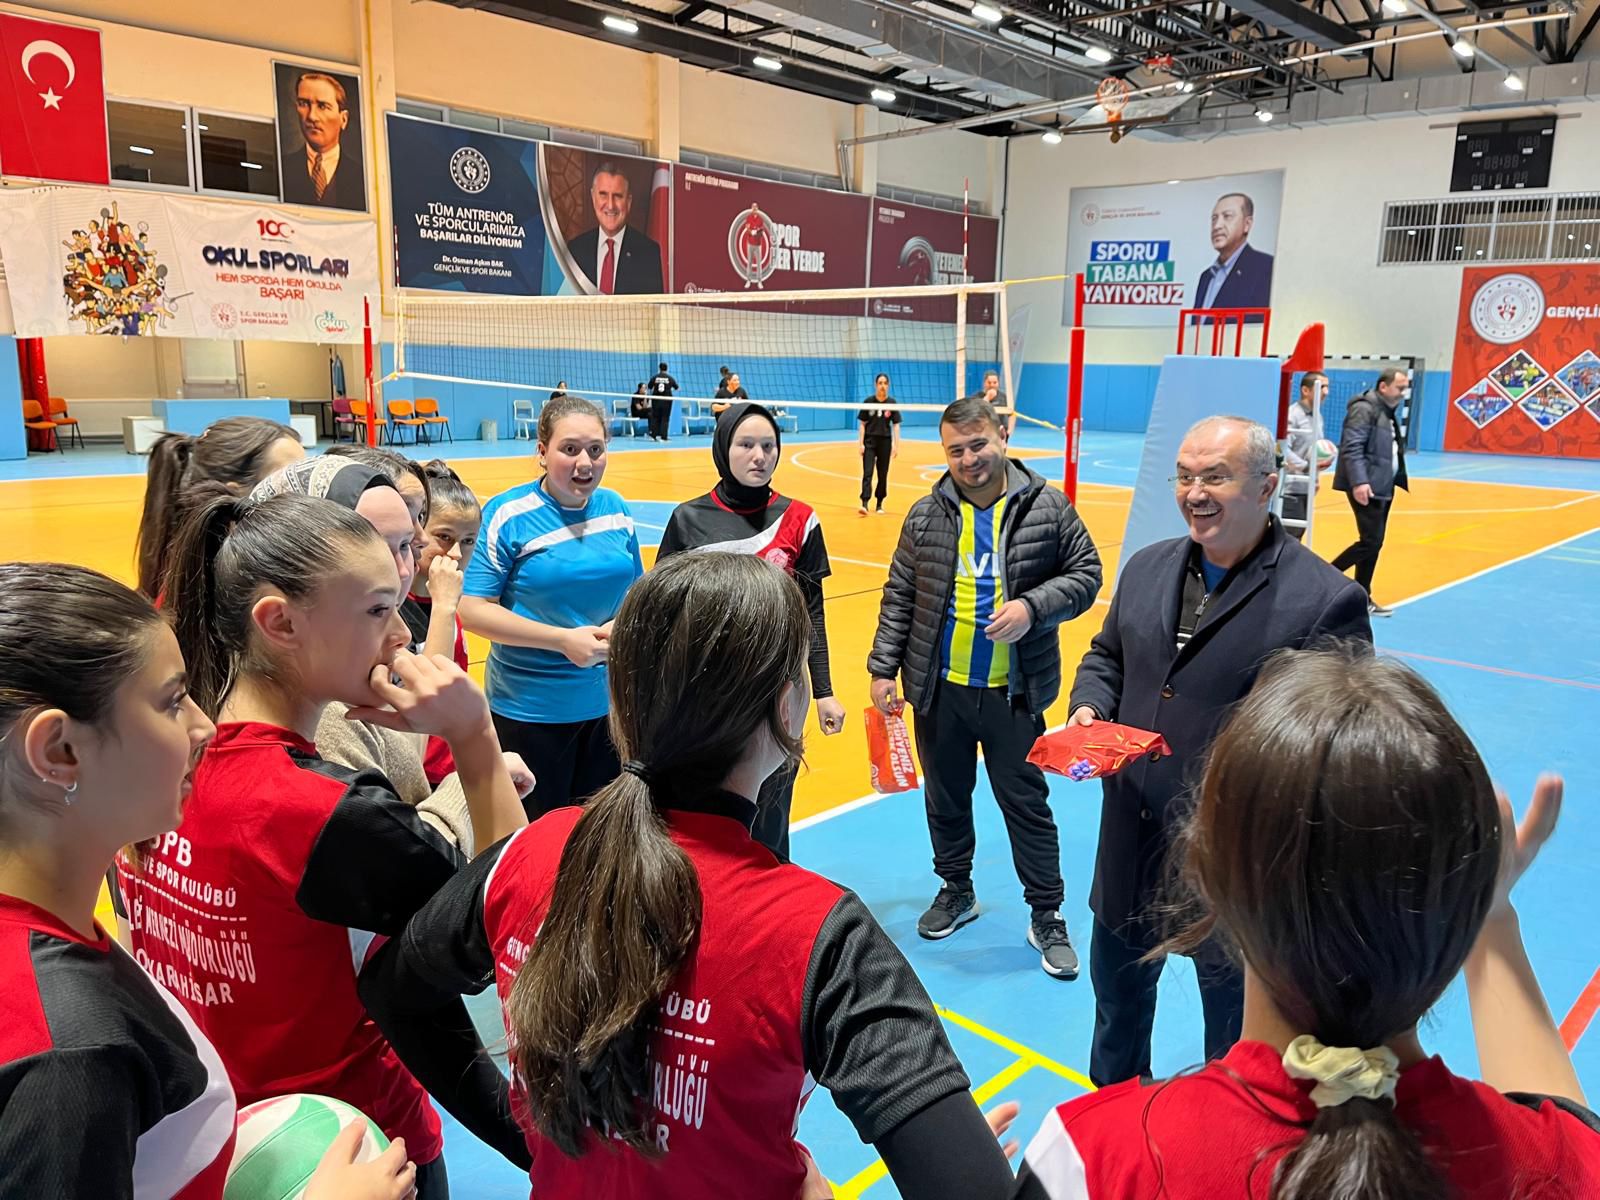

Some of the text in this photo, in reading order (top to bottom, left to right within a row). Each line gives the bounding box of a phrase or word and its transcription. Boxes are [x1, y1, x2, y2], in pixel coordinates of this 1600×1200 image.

[427, 202, 513, 224] TÜM ANTRENÖR
[415, 213, 526, 238] VE SPORCULARIMIZA
[420, 228, 523, 249] BAŞARILAR DİLİYORUM
[202, 245, 349, 279] OKUL SPORLARI
[792, 249, 825, 273] YERDE
[1095, 243, 1160, 261] SPORU
[216, 273, 343, 292] HEM SPORDA HEM OKULDA
[1091, 262, 1168, 282] TABANA
[260, 286, 305, 301] BAŞARI
[1083, 284, 1183, 304] YAYIYORUZ
[1546, 303, 1600, 321] GENÇLİ
[957, 552, 999, 578] AVI
[156, 861, 179, 890] SPOR
[181, 875, 237, 908] KULÜBÜ
